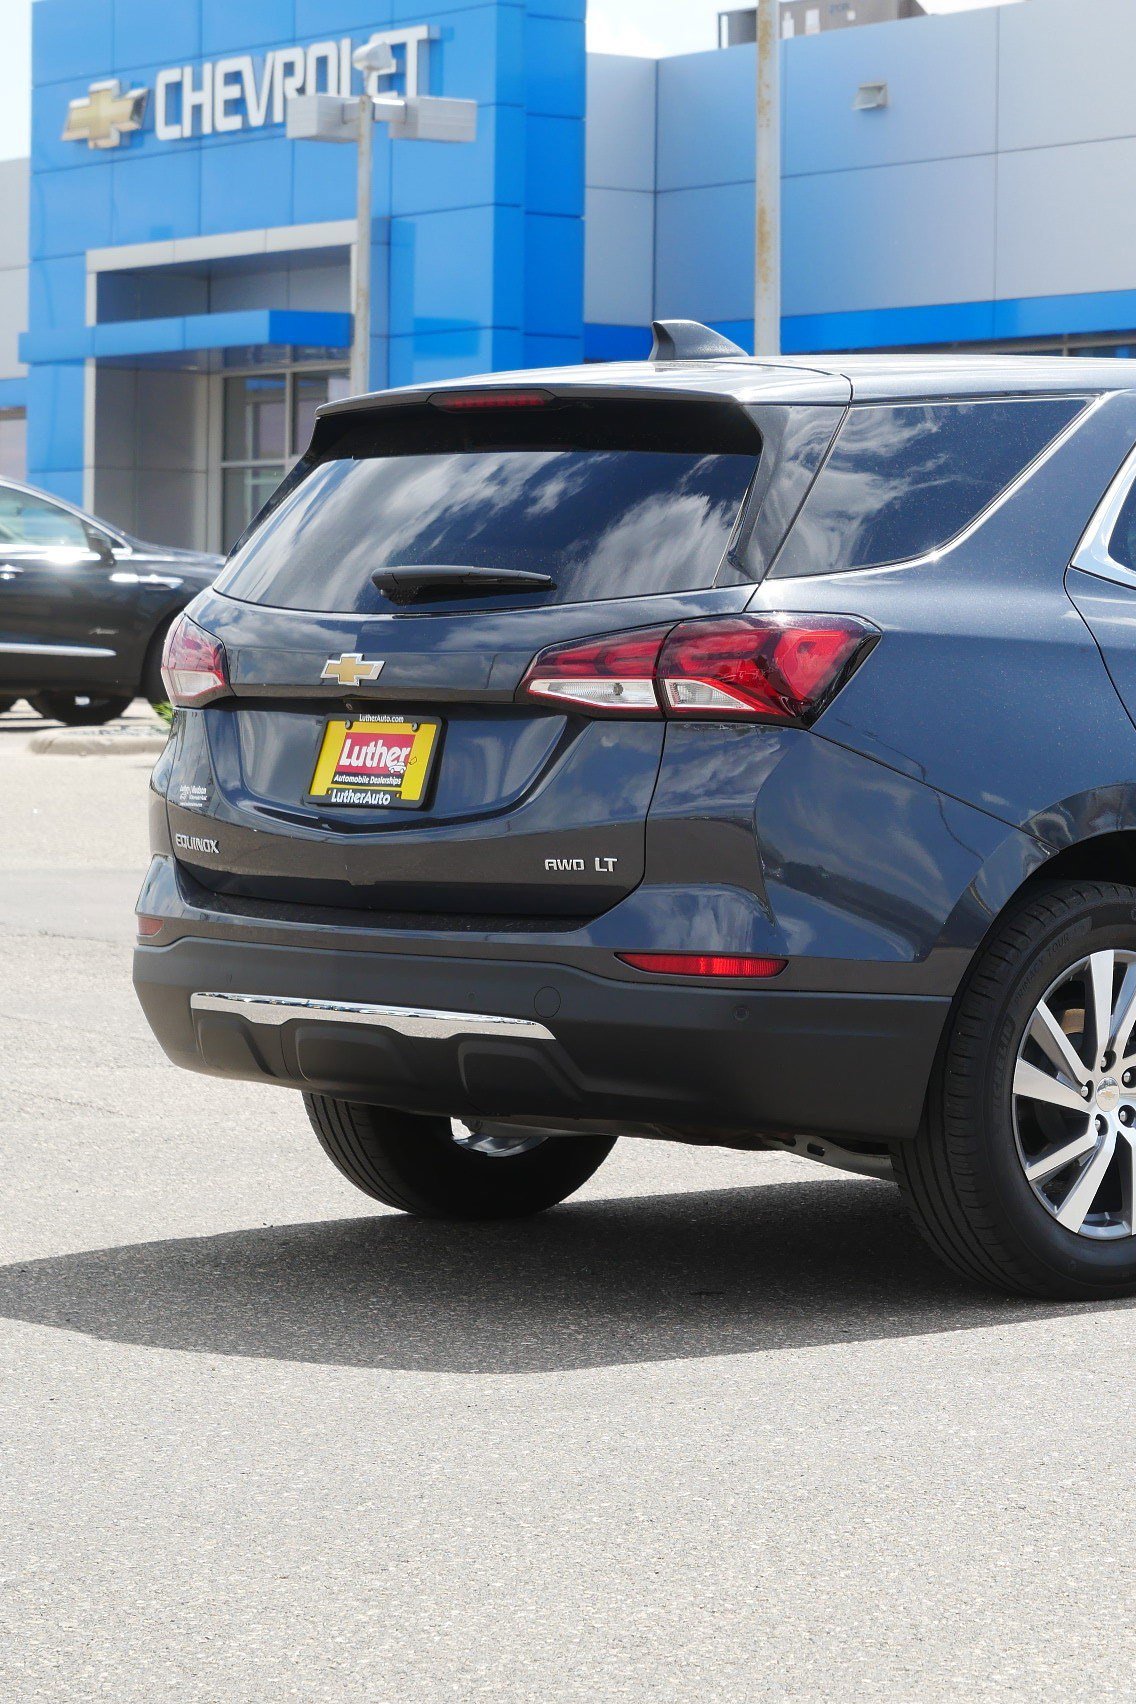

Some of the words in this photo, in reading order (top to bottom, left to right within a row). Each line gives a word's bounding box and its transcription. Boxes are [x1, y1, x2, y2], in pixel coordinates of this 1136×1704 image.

[359, 714, 404, 723] LutherAuto.com
[339, 739, 411, 768] Luther
[334, 774, 369, 784] Automobile
[370, 776, 402, 785] Dealerships
[331, 789, 391, 805] LutherAuto
[175, 833, 219, 854] EQUINOX
[544, 859, 585, 871] AWD
[594, 857, 618, 872] LT
